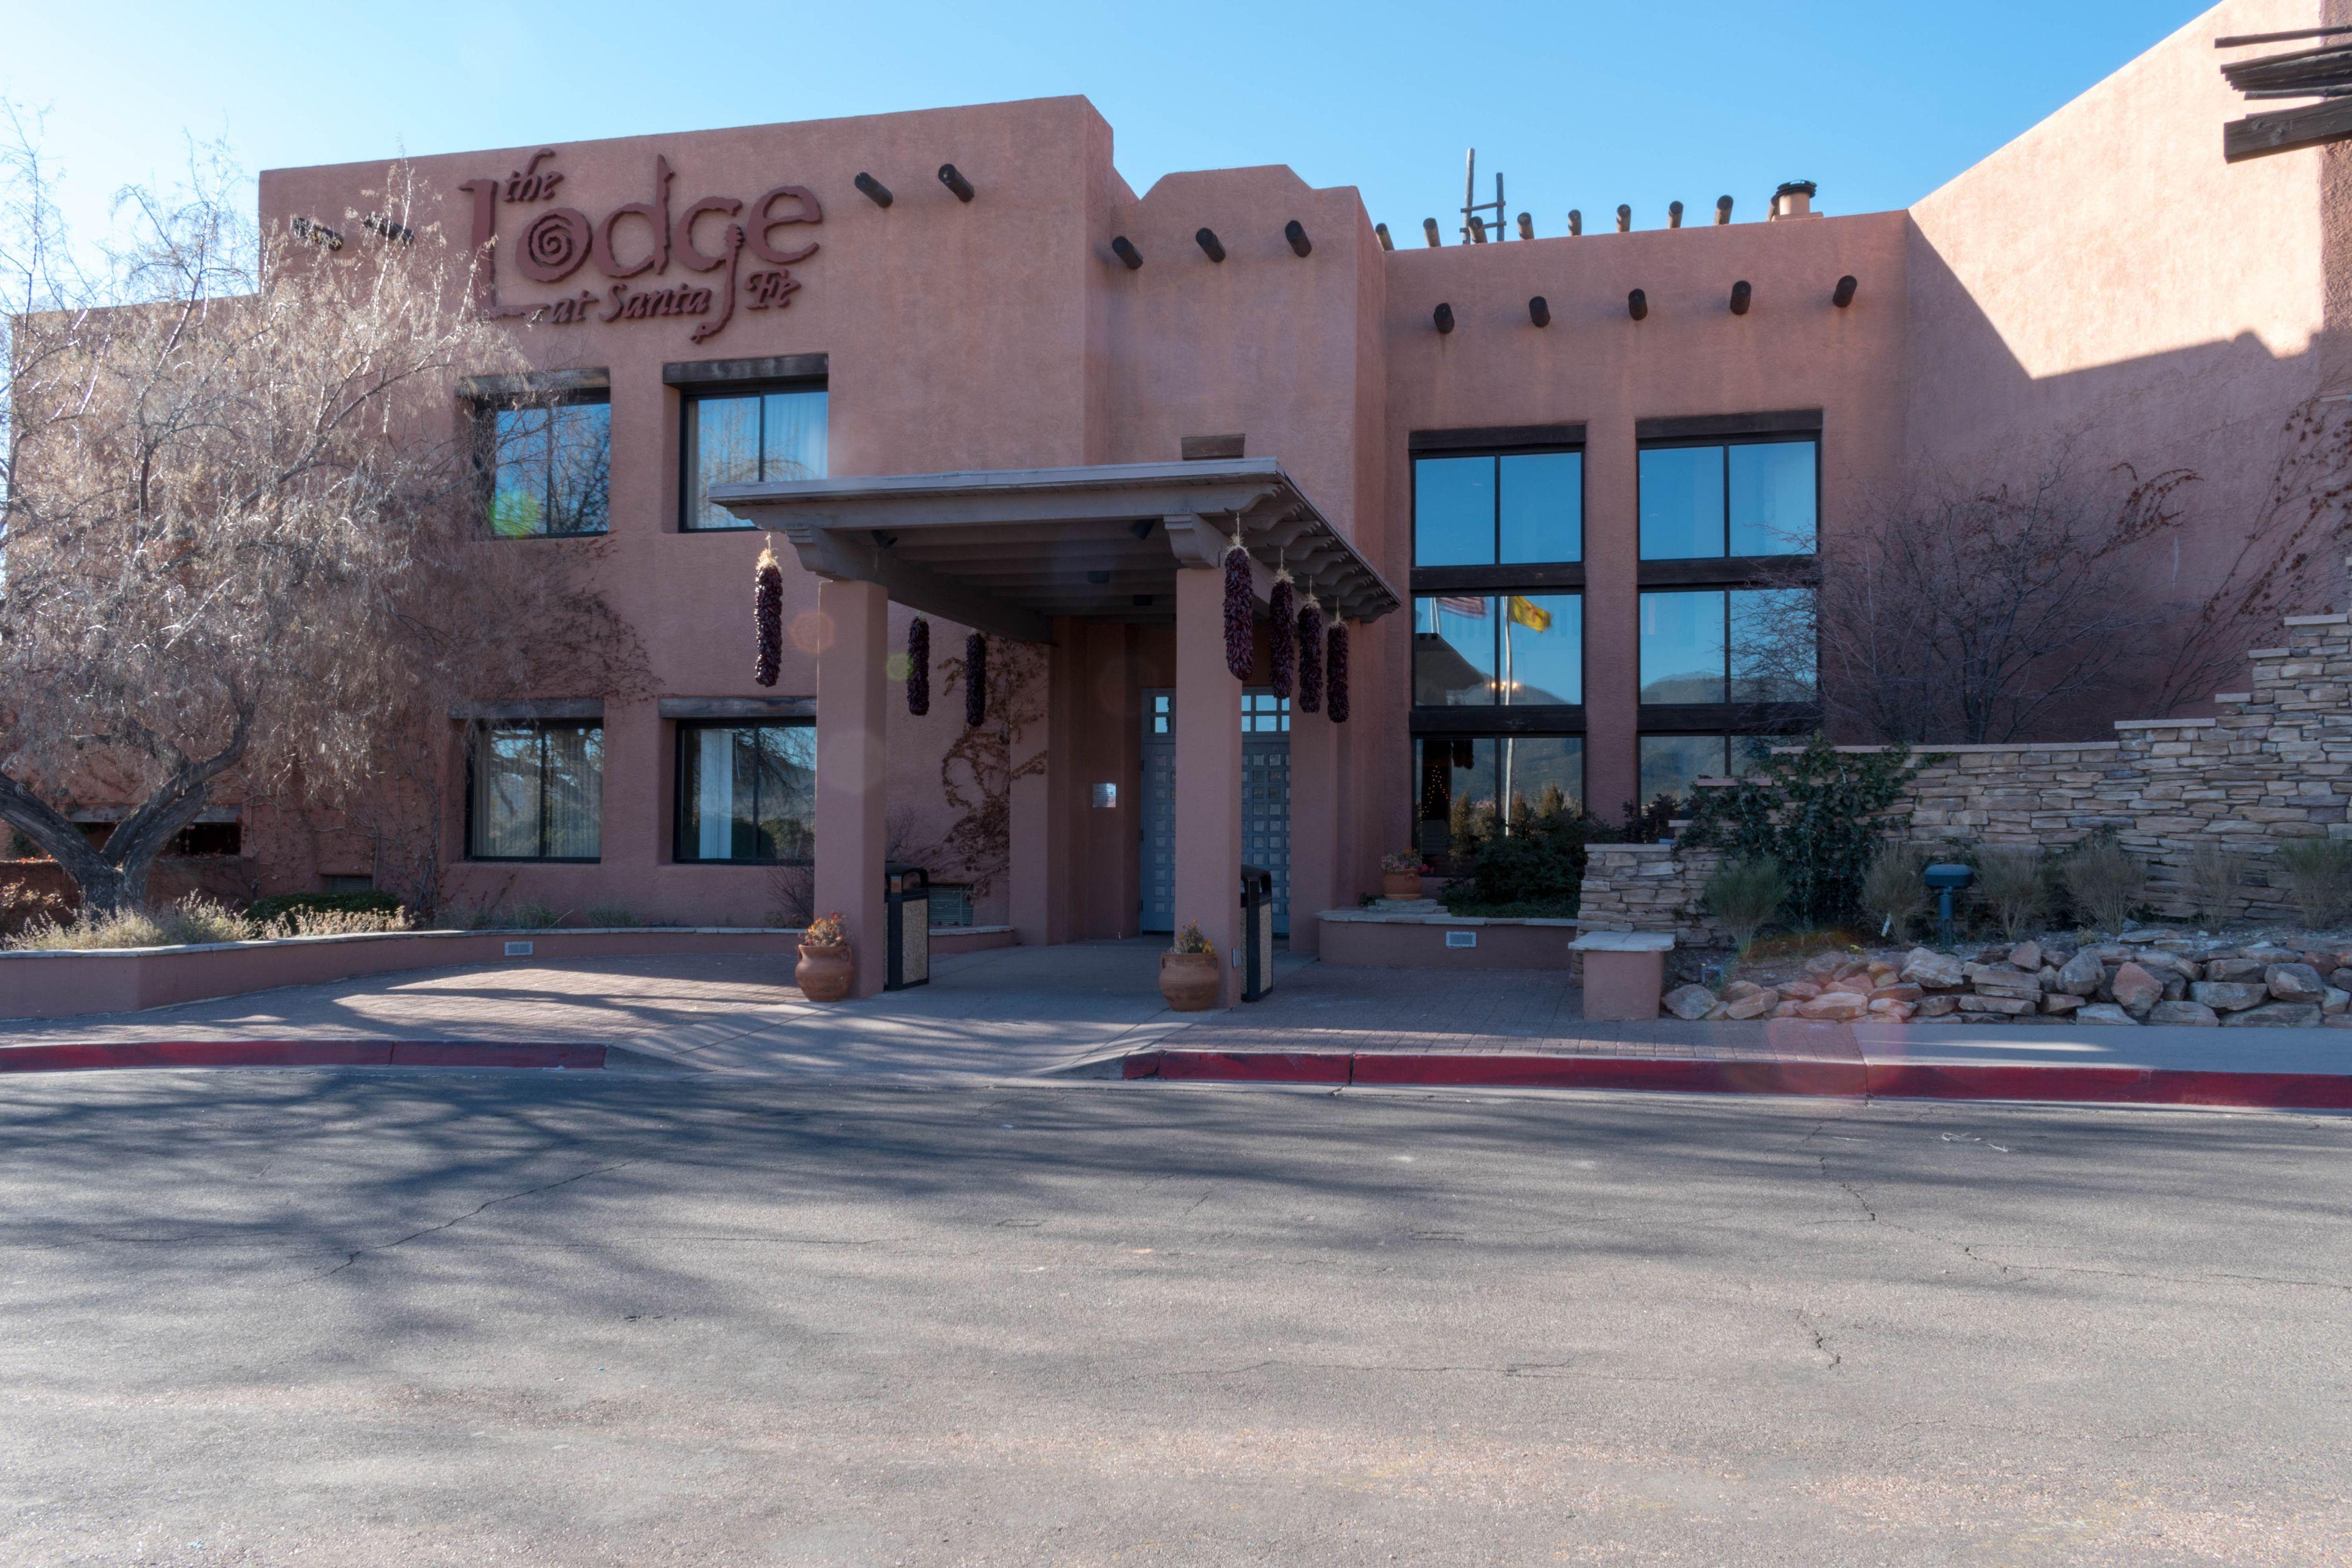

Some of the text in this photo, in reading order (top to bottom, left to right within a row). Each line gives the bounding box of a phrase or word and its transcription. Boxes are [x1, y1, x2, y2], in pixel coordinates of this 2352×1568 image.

[505, 147, 565, 203] the
[458, 154, 823, 345] Lodge
[548, 268, 801, 324] at Santa Fe
